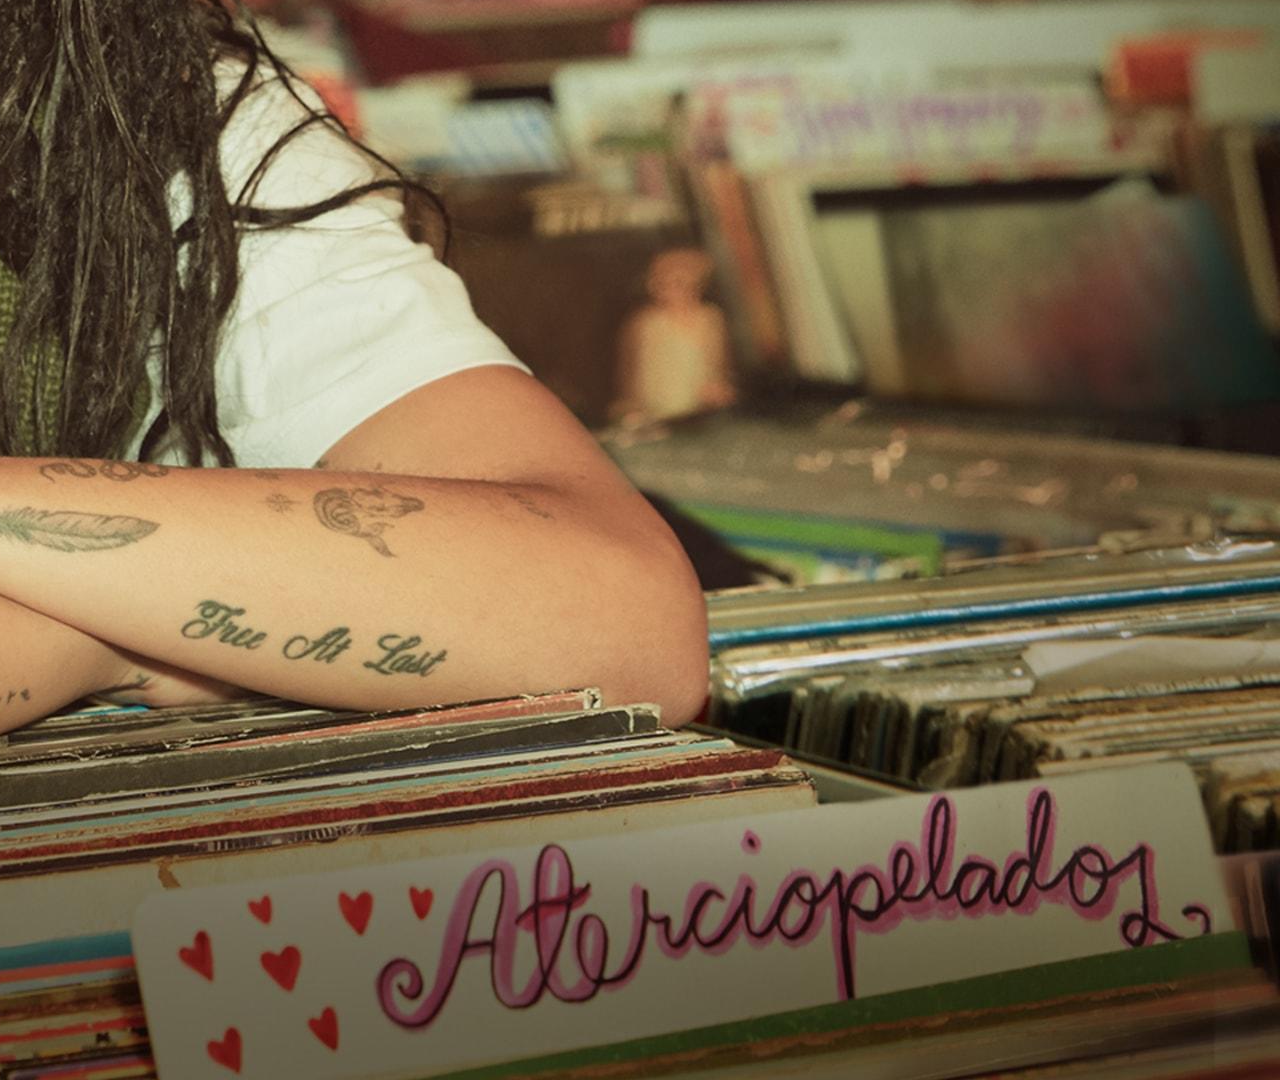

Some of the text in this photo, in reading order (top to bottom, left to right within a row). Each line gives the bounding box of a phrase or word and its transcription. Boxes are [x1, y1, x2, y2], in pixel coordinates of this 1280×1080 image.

[180, 599, 448, 678] Free At Last
